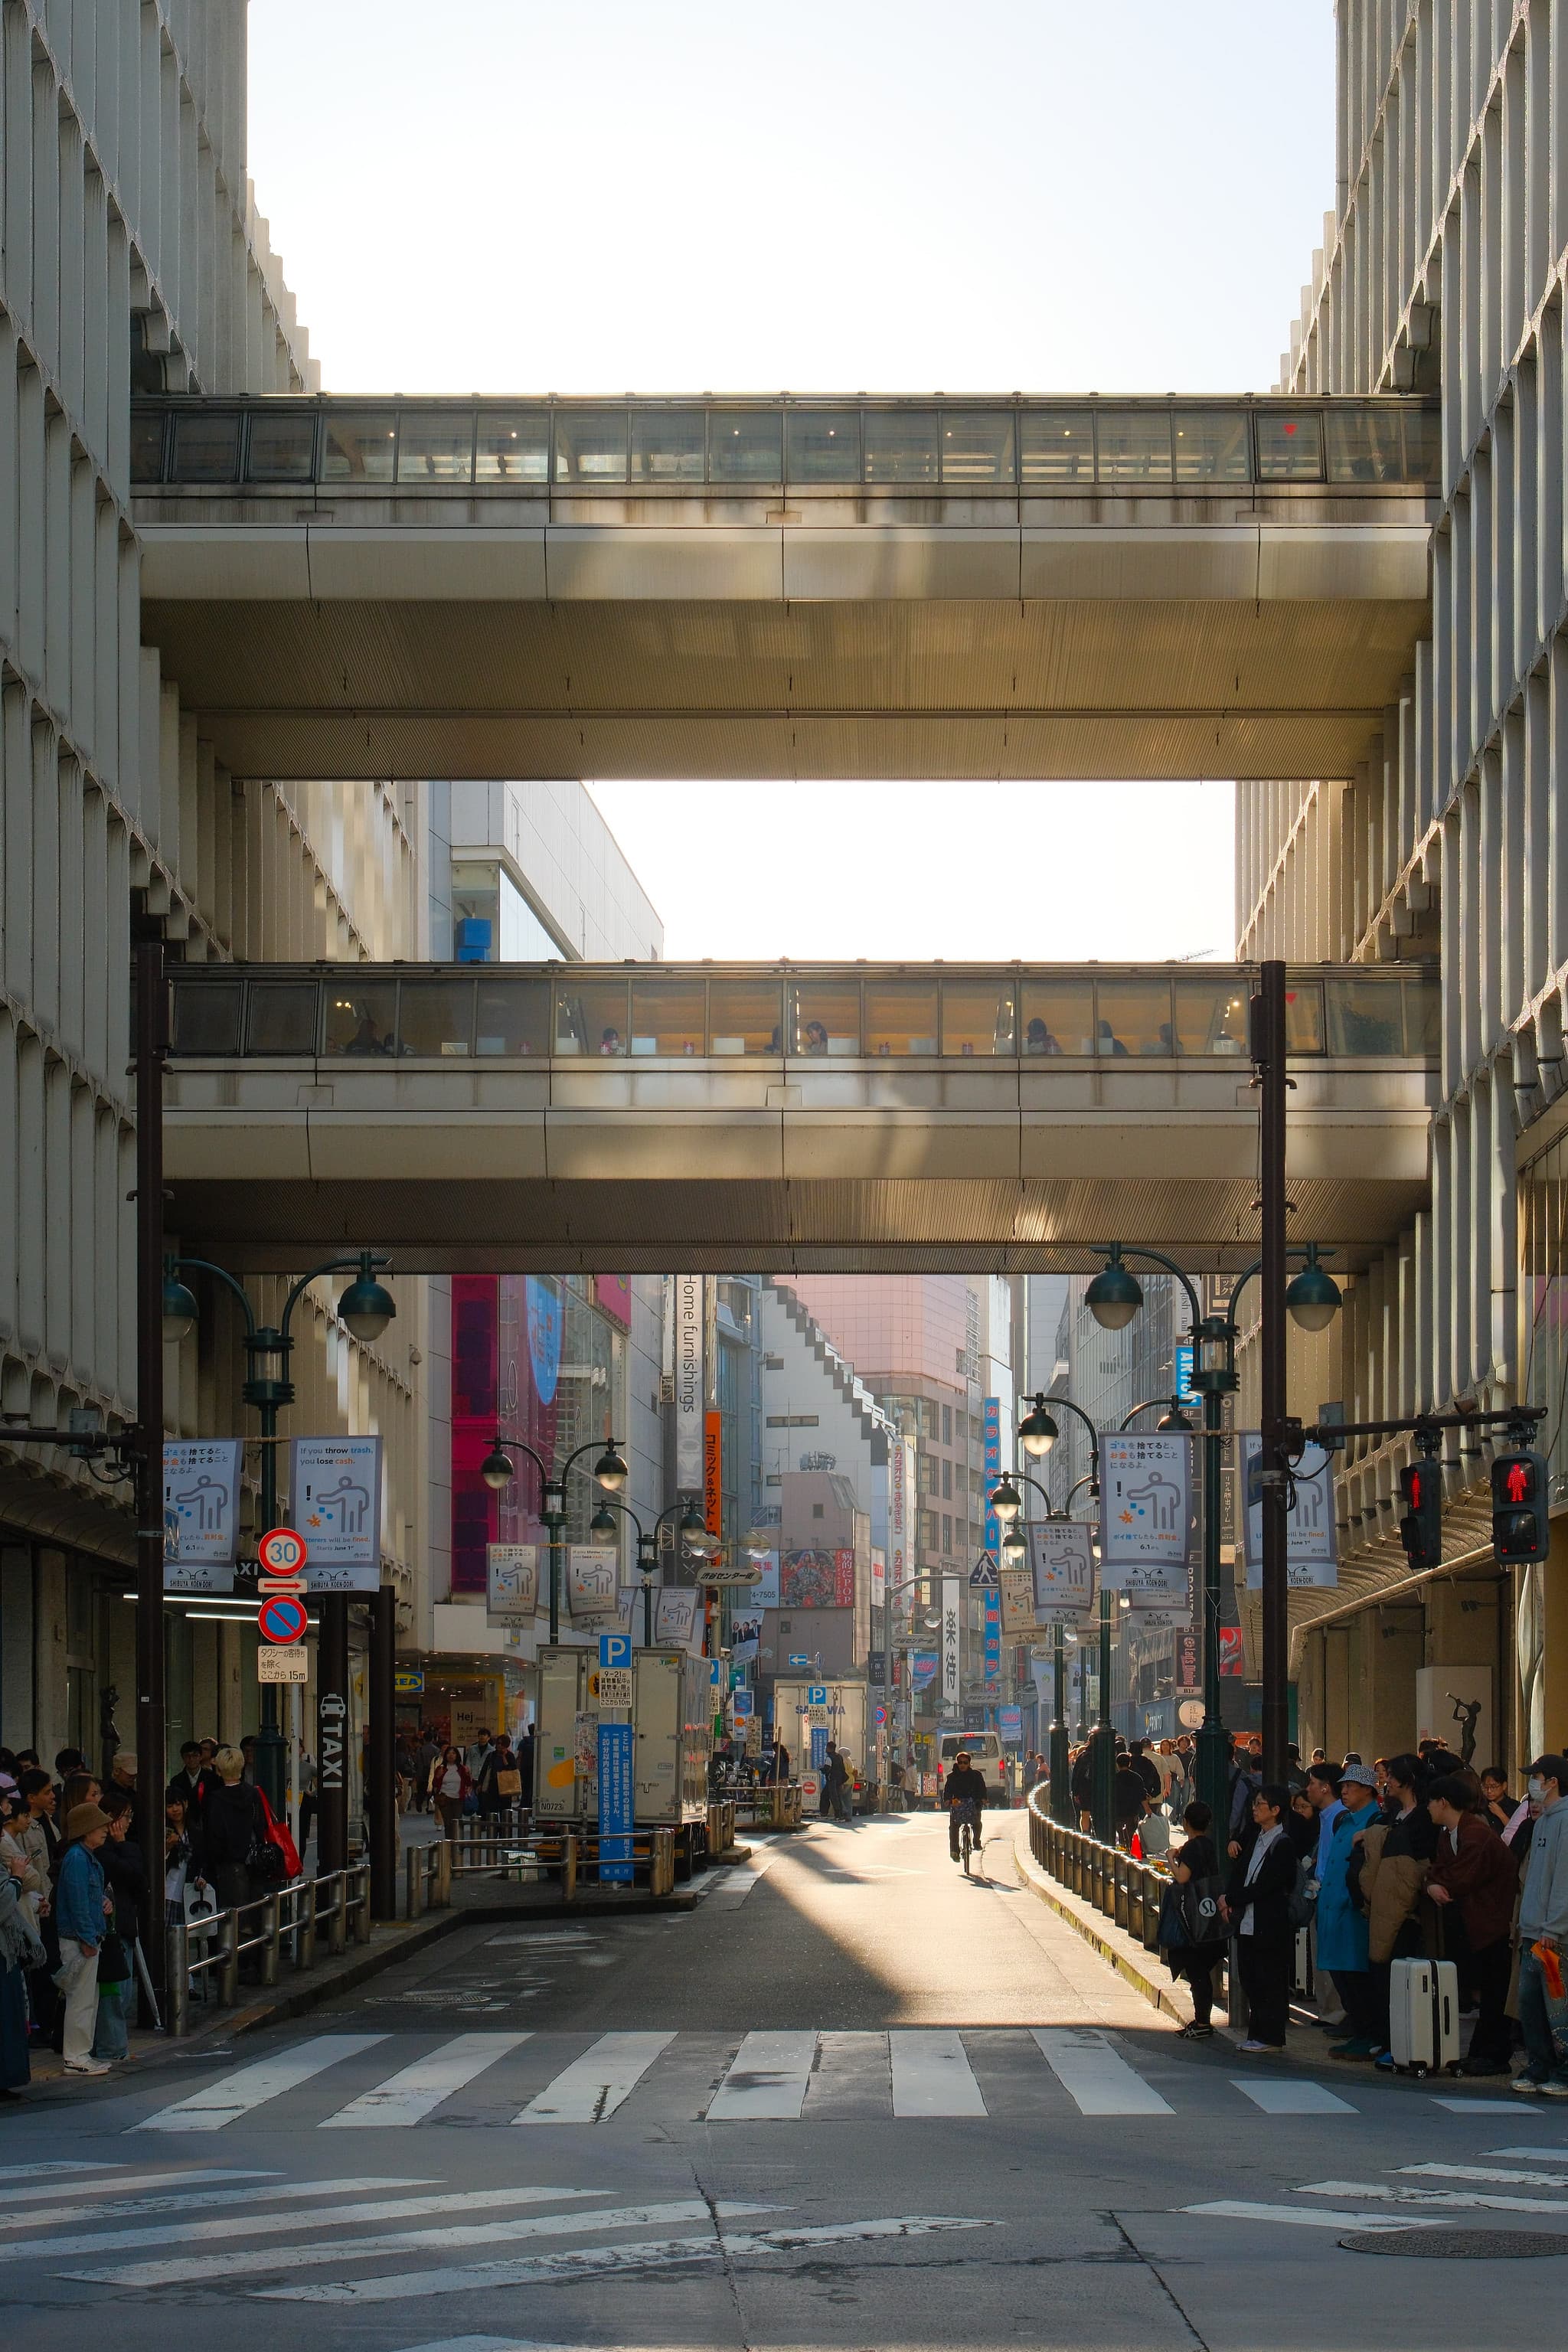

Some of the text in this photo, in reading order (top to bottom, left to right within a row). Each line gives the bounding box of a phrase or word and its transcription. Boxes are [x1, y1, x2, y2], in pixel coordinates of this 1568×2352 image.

[680, 1325, 697, 1413] furnishings
[270, 1542, 296, 1563] 30
[260, 1648, 305, 1658] タクシーの客待ち
[607, 1638, 626, 1664] P
[946, 1609, 956, 1690] 楽待
[261, 1660, 280, 1668] を除く
[261, 1671, 305, 1680] ここから 15m
[813, 1688, 823, 1703] P
[457, 1712, 473, 1723] Hej
[795, 1706, 846, 1715] SAWA
[322, 1722, 342, 1788] TAXI
